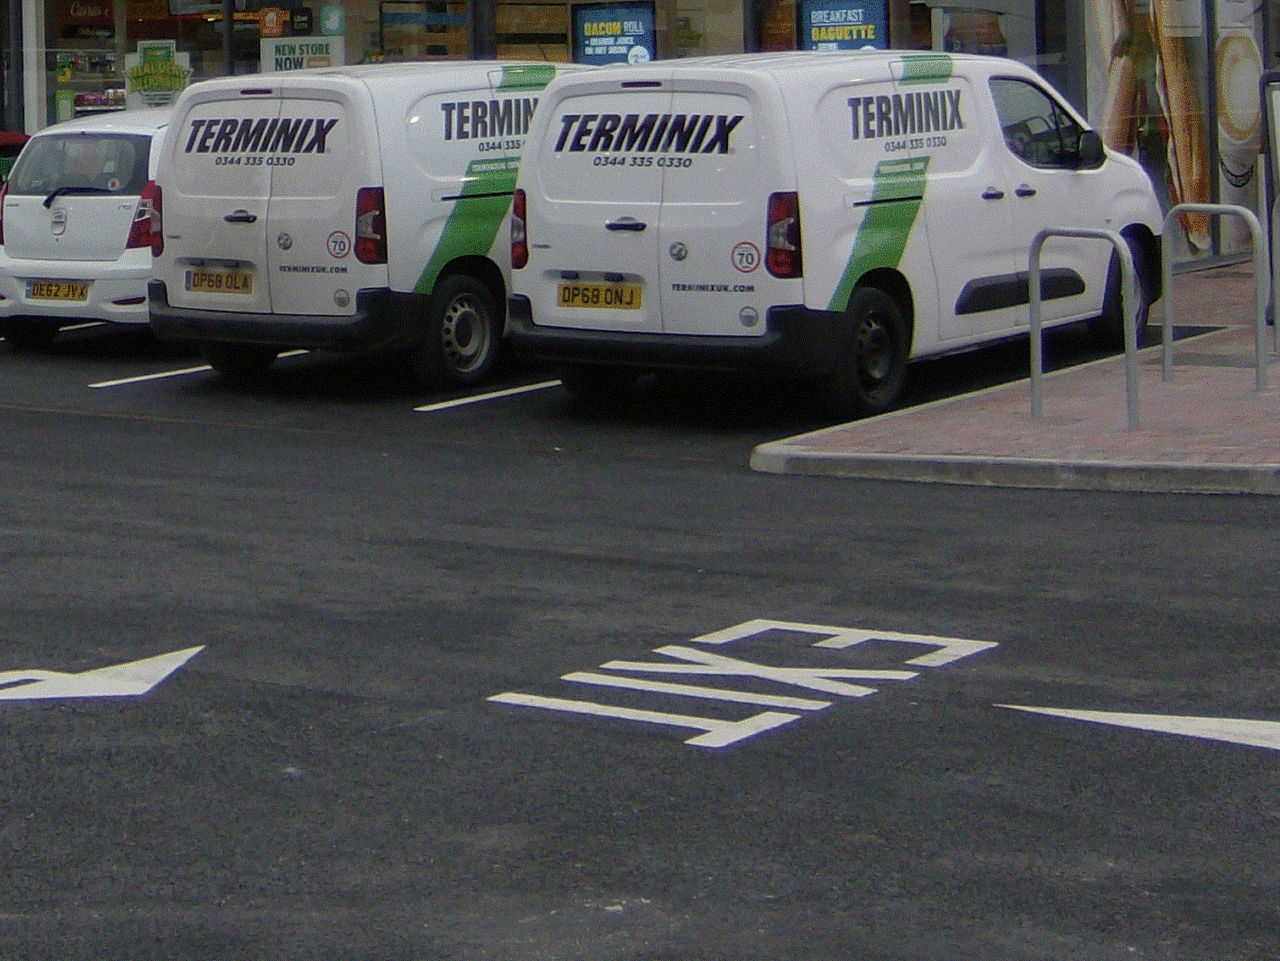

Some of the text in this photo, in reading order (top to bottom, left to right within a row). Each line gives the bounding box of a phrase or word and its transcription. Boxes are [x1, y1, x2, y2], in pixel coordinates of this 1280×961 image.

[811, 9, 864, 23] BREAKFAST
[584, 21, 644, 35] BACON ROLL
[811, 25, 876, 41] BAGUETTE
[274, 43, 330, 56] NEW STORE
[274, 57, 304, 71] NOW
[847, 89, 964, 140] TERMINIX
[184, 118, 340, 154] TERMINIX
[554, 113, 744, 154] TERMINIX
[478, 140, 521, 152] 0344 335
[884, 136, 947, 153] 0344 335 0330
[215, 156, 295, 166] 0344 335 0330
[593, 156, 692, 168] 0344 335 0330
[331, 241, 346, 252] 70
[737, 252, 754, 265] 70
[32, 282, 61, 297] DE62
[562, 286, 634, 305] DP68 ONJ
[486, 618, 999, 748] EXIT
